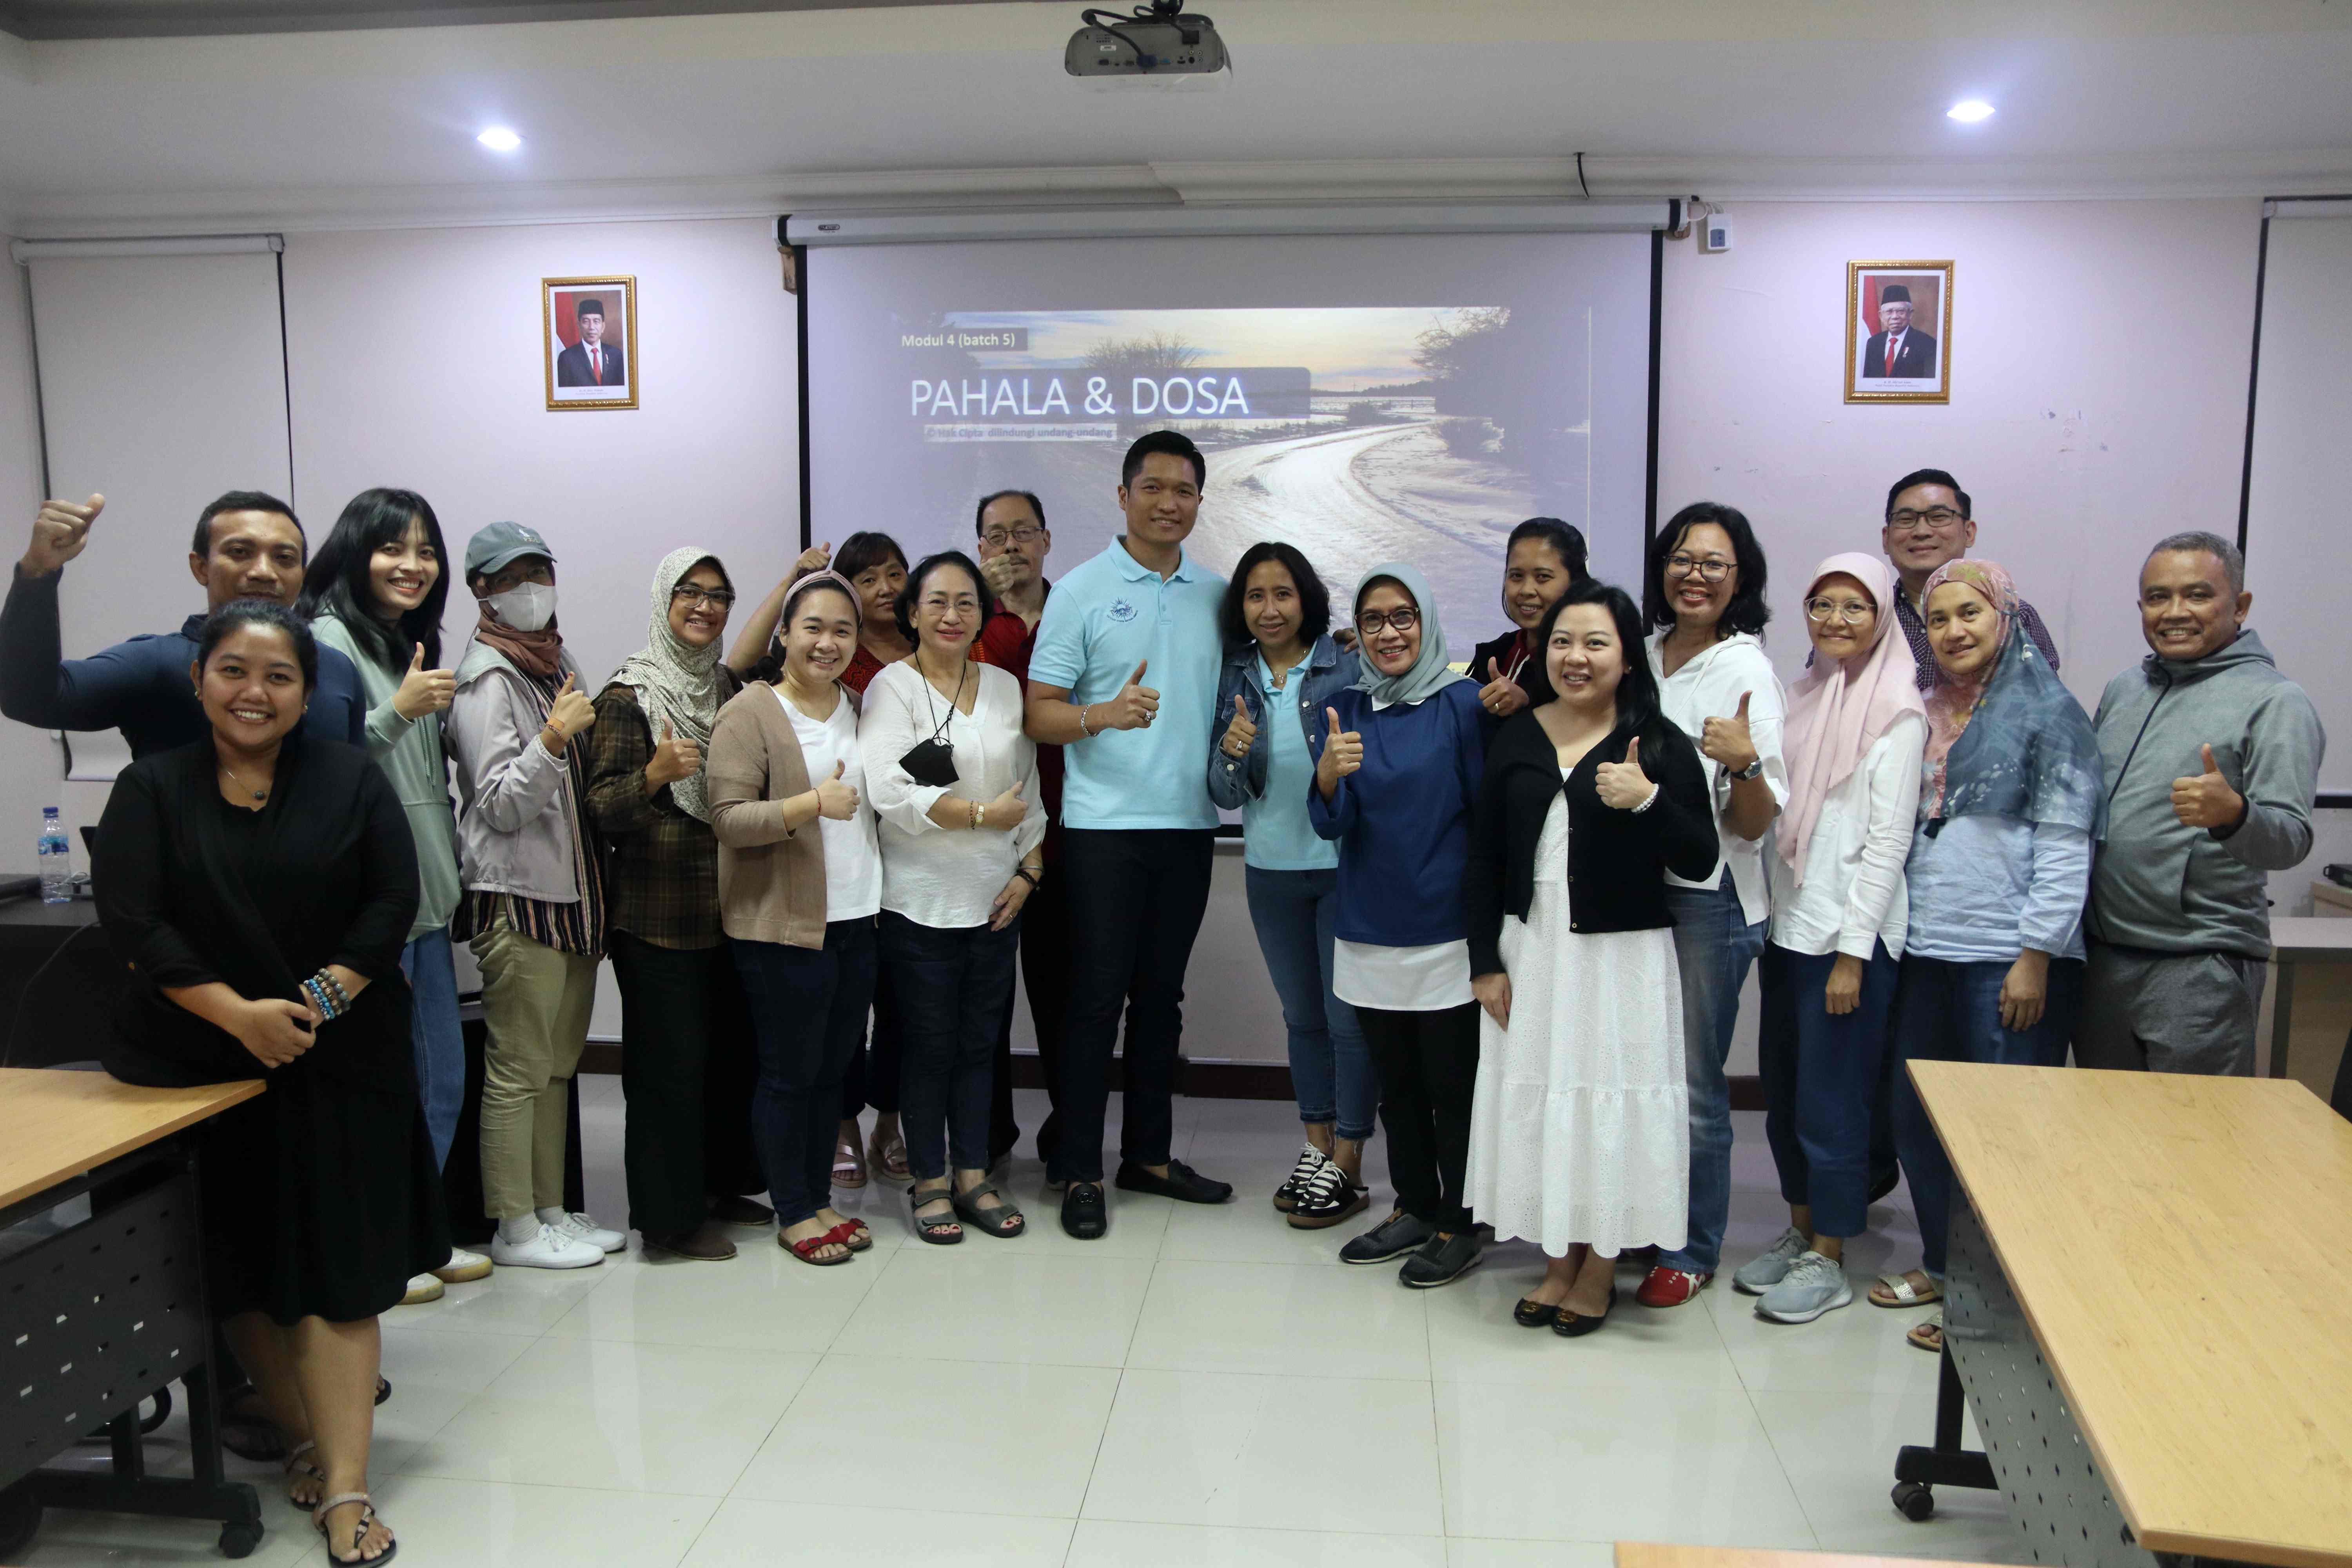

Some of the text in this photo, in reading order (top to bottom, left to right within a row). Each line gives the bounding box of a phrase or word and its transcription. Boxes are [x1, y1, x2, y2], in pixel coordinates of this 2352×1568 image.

[902, 332, 1015, 348] Modul 4 (batch 5)
[911, 376, 1249, 416] PAHALA & DOSA
[959, 428, 983, 438] Cipta
[988, 427, 1035, 438] dilindungi
[1038, 427, 1112, 438] undang-undang
